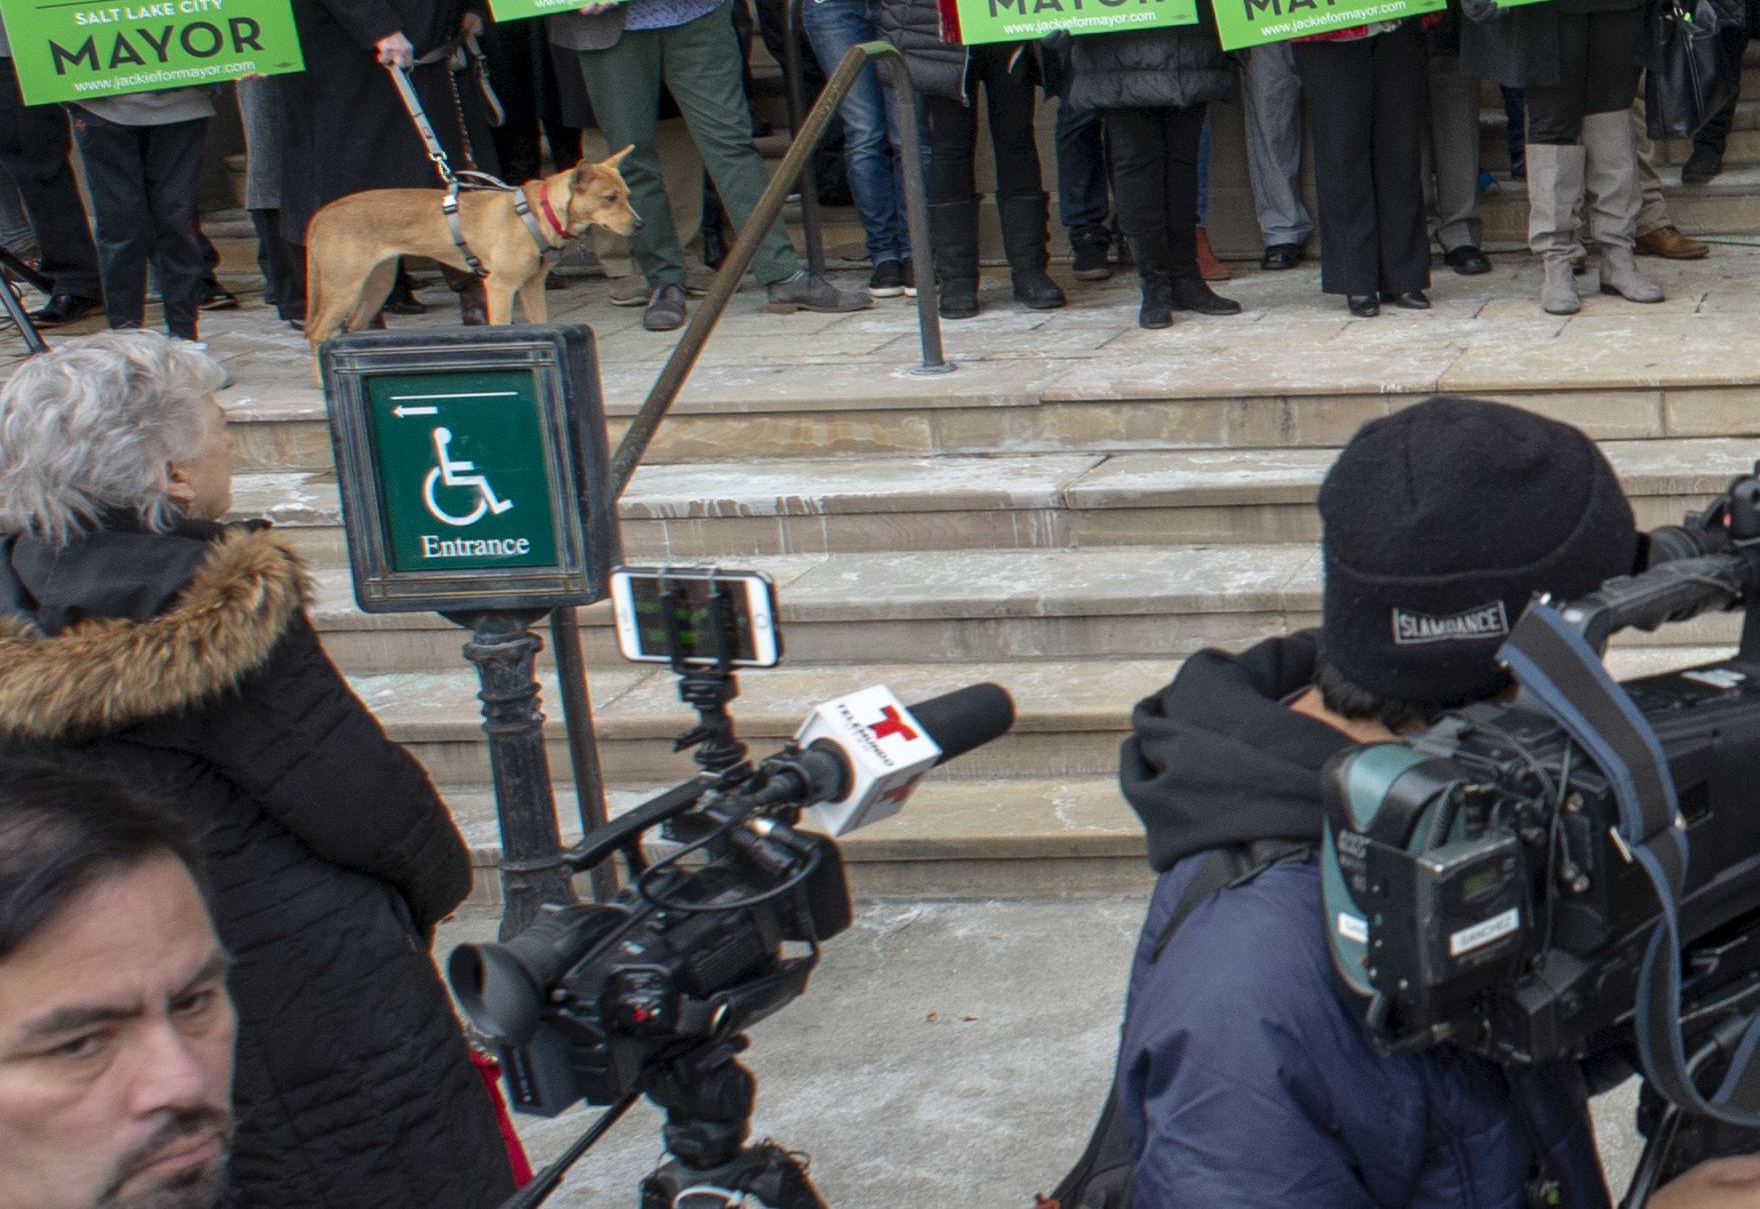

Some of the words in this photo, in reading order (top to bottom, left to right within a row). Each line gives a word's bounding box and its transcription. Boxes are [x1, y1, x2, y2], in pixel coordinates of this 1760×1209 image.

[75, 8, 121, 26] SALT
[125, 2, 175, 20] LAKE
[1003, 11, 1156, 34] www.jackieformayor.com
[1261, 1, 1406, 36] www.jackieformayor.com
[48, 17, 265, 75] MAYOR
[73, 60, 256, 92] www.jackieformayor.com
[420, 535, 530, 557] Entrance
[837, 703, 895, 766] TELEMUNDO
